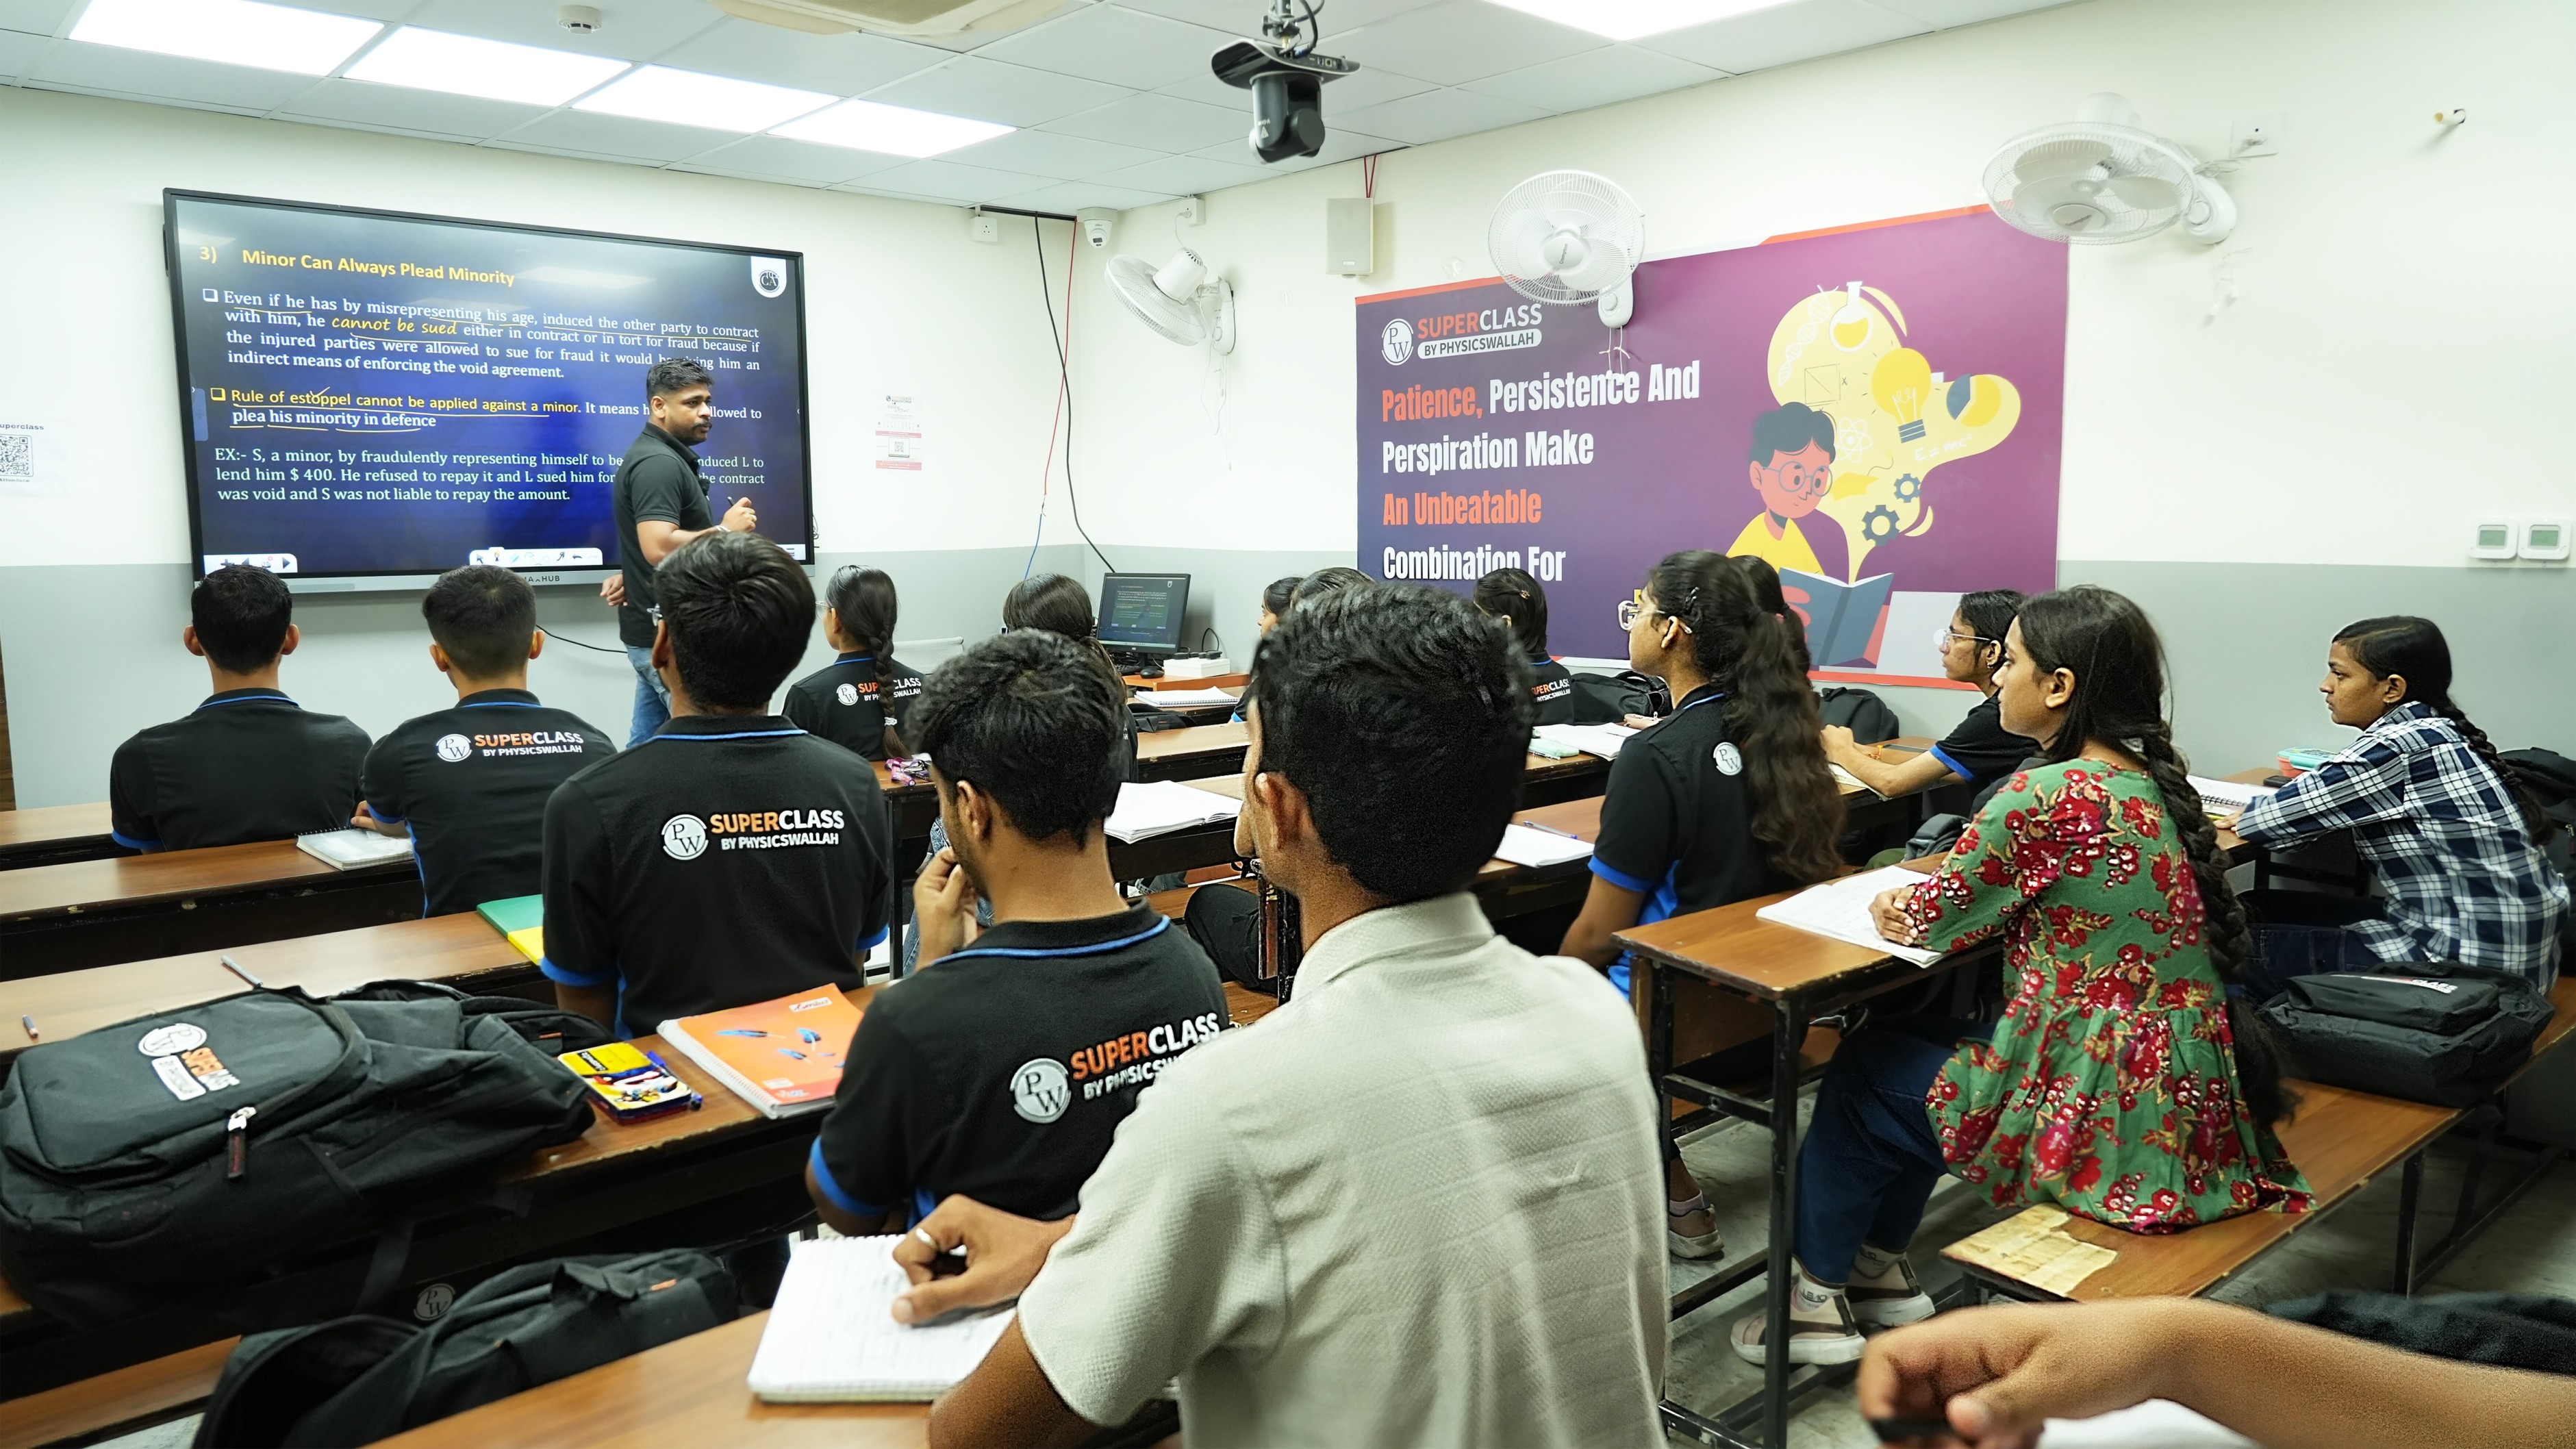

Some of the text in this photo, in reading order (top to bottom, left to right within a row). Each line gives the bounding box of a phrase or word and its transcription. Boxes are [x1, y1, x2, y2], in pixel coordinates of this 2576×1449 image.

[199, 246, 514, 287] 3) Minor Can Always Plead Minority
[224, 290, 759, 338] Even if he has by misrepresenting his age, induced the other party to contract
[1418, 303, 1542, 338] SUPERCLASS
[225, 310, 760, 353] with him, he cannot be sued either in contract or in tort for fraud because if
[1425, 332, 1534, 356] BY PHYSICSWALLAH
[226, 330, 252, 343] the
[260, 332, 316, 348] injured
[324, 337, 375, 351] parties
[383, 342, 418, 353] were
[426, 342, 479, 355] allowed
[485, 345, 499, 357] to
[506, 349, 529, 357] sue
[535, 347, 553, 360] for
[560, 349, 594, 362] fraud
[601, 351, 609, 362] it
[616, 353, 653, 364] would
[719, 357, 740, 369] him
[746, 362, 759, 370] an
[228, 351, 564, 377] indirect means of enforcing the void agreement.
[231, 390, 264, 402] Rule
[270, 392, 284, 403] of
[290, 392, 351, 407] estoppel
[356, 396, 403, 407] cannot
[408, 396, 425, 407] be
[430, 397, 477, 410] applied
[483, 400, 526, 412] against
[531, 403, 538, 411] a
[543, 402, 581, 413] minor.
[585, 402, 596, 413] It
[600, 405, 639, 415] means
[710, 407, 746, 418] llowed
[751, 407, 761, 418] to
[1382, 360, 1700, 423] Patience, Persistence And
[233, 409, 436, 427] plea his minority in defence
[215, 448, 247, 461] EX:-
[253, 449, 266, 462] S,
[271, 453, 279, 461] a
[286, 450, 333, 464] minor,
[338, 450, 356, 465] by
[362, 450, 447, 466] fraudulently
[453, 453, 537, 467] representing
[542, 453, 588, 465] himself
[592, 455, 604, 465] to
[698, 456, 737, 467] nduced
[742, 457, 749, 466] L
[753, 457, 763, 467] to
[1382, 429, 1594, 475] Perspiration Make
[216, 467, 250, 480] lend
[256, 468, 285, 480] him
[290, 468, 299, 481] $
[303, 468, 336, 481] 400.
[340, 470, 360, 481] He
[365, 469, 418, 481] refused
[422, 470, 436, 481] to
[441, 473, 479, 484] repay
[483, 471, 493, 482] it
[497, 470, 520, 482] and
[525, 471, 533, 482] L
[537, 471, 566, 482] sued
[570, 471, 596, 482] him
[598, 471, 616, 482] for
[719, 474, 764, 483] contract
[218, 488, 570, 502] was void and S was not liable to repay the amount.
[1383, 489, 1542, 525] An Unbeatable
[1383, 544, 1566, 581] Combination For
[475, 731, 583, 747] SUPERCLASS
[498, 745, 583, 756] PHYSICSWALLAH
[711, 809, 844, 833] SUPERCLASS
[721, 833, 839, 850] BY PHYSICSWALLAH
[1070, 1012, 1221, 1080] SUPERCLASS
[1083, 1079, 1102, 1100] BY
